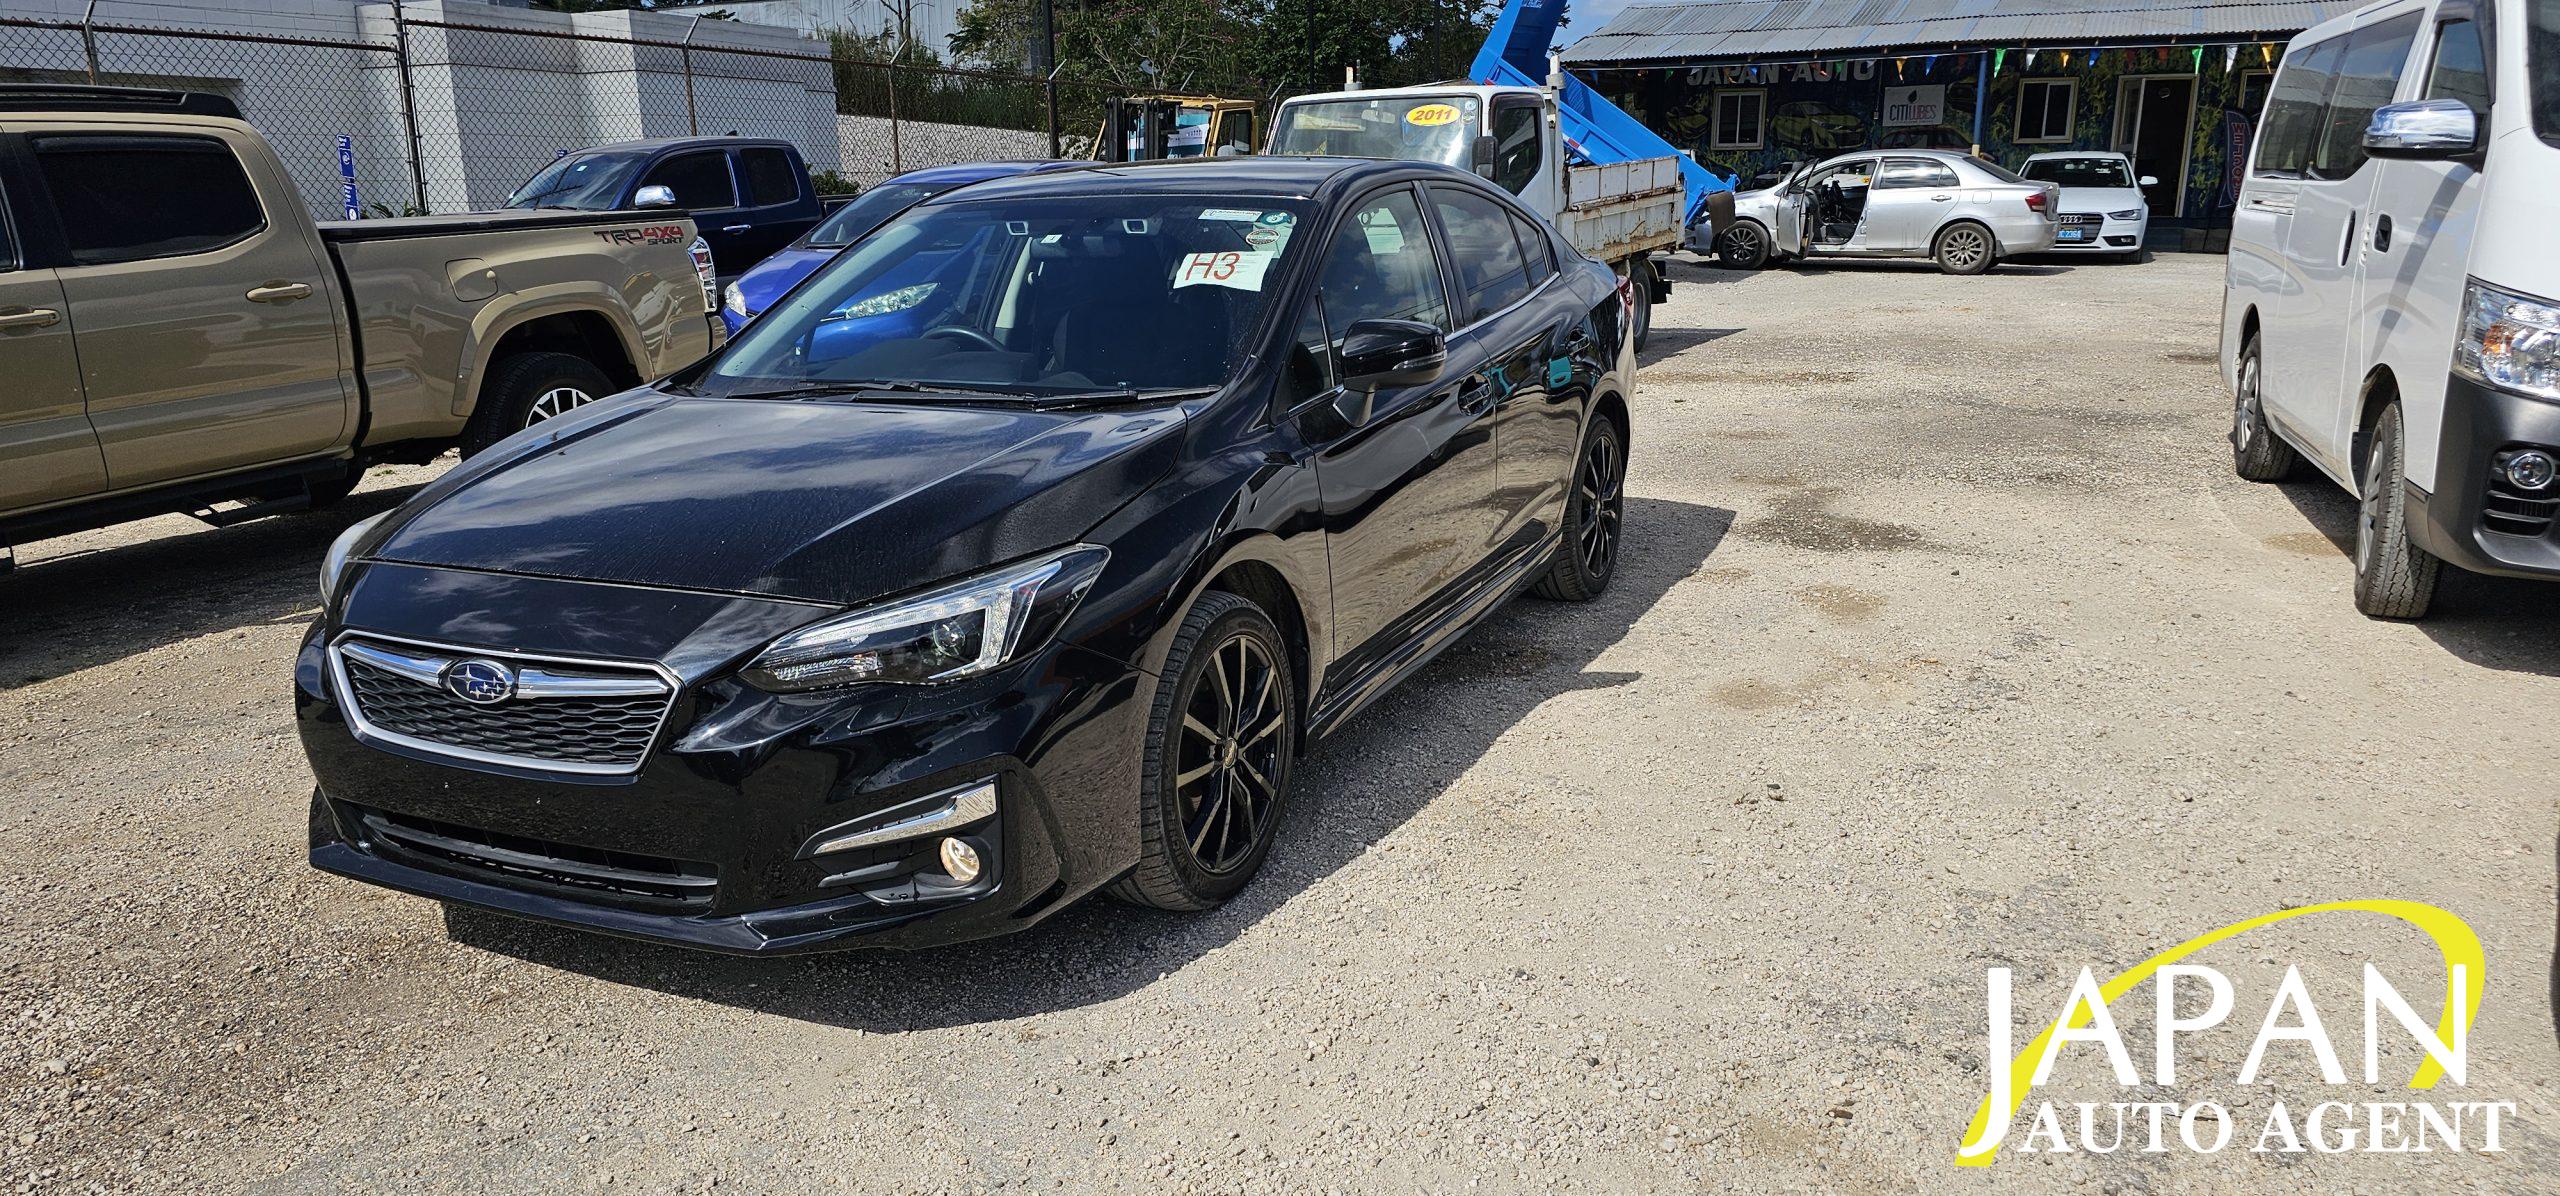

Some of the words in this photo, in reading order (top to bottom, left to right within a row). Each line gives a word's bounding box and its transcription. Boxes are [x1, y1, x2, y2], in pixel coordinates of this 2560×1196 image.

[1686, 64, 1779, 86] JAPAN
[1413, 109, 1453, 121] 2011
[594, 229, 642, 246] TRD
[648, 237, 683, 246] SPORT
[1185, 252, 1240, 280] H3
